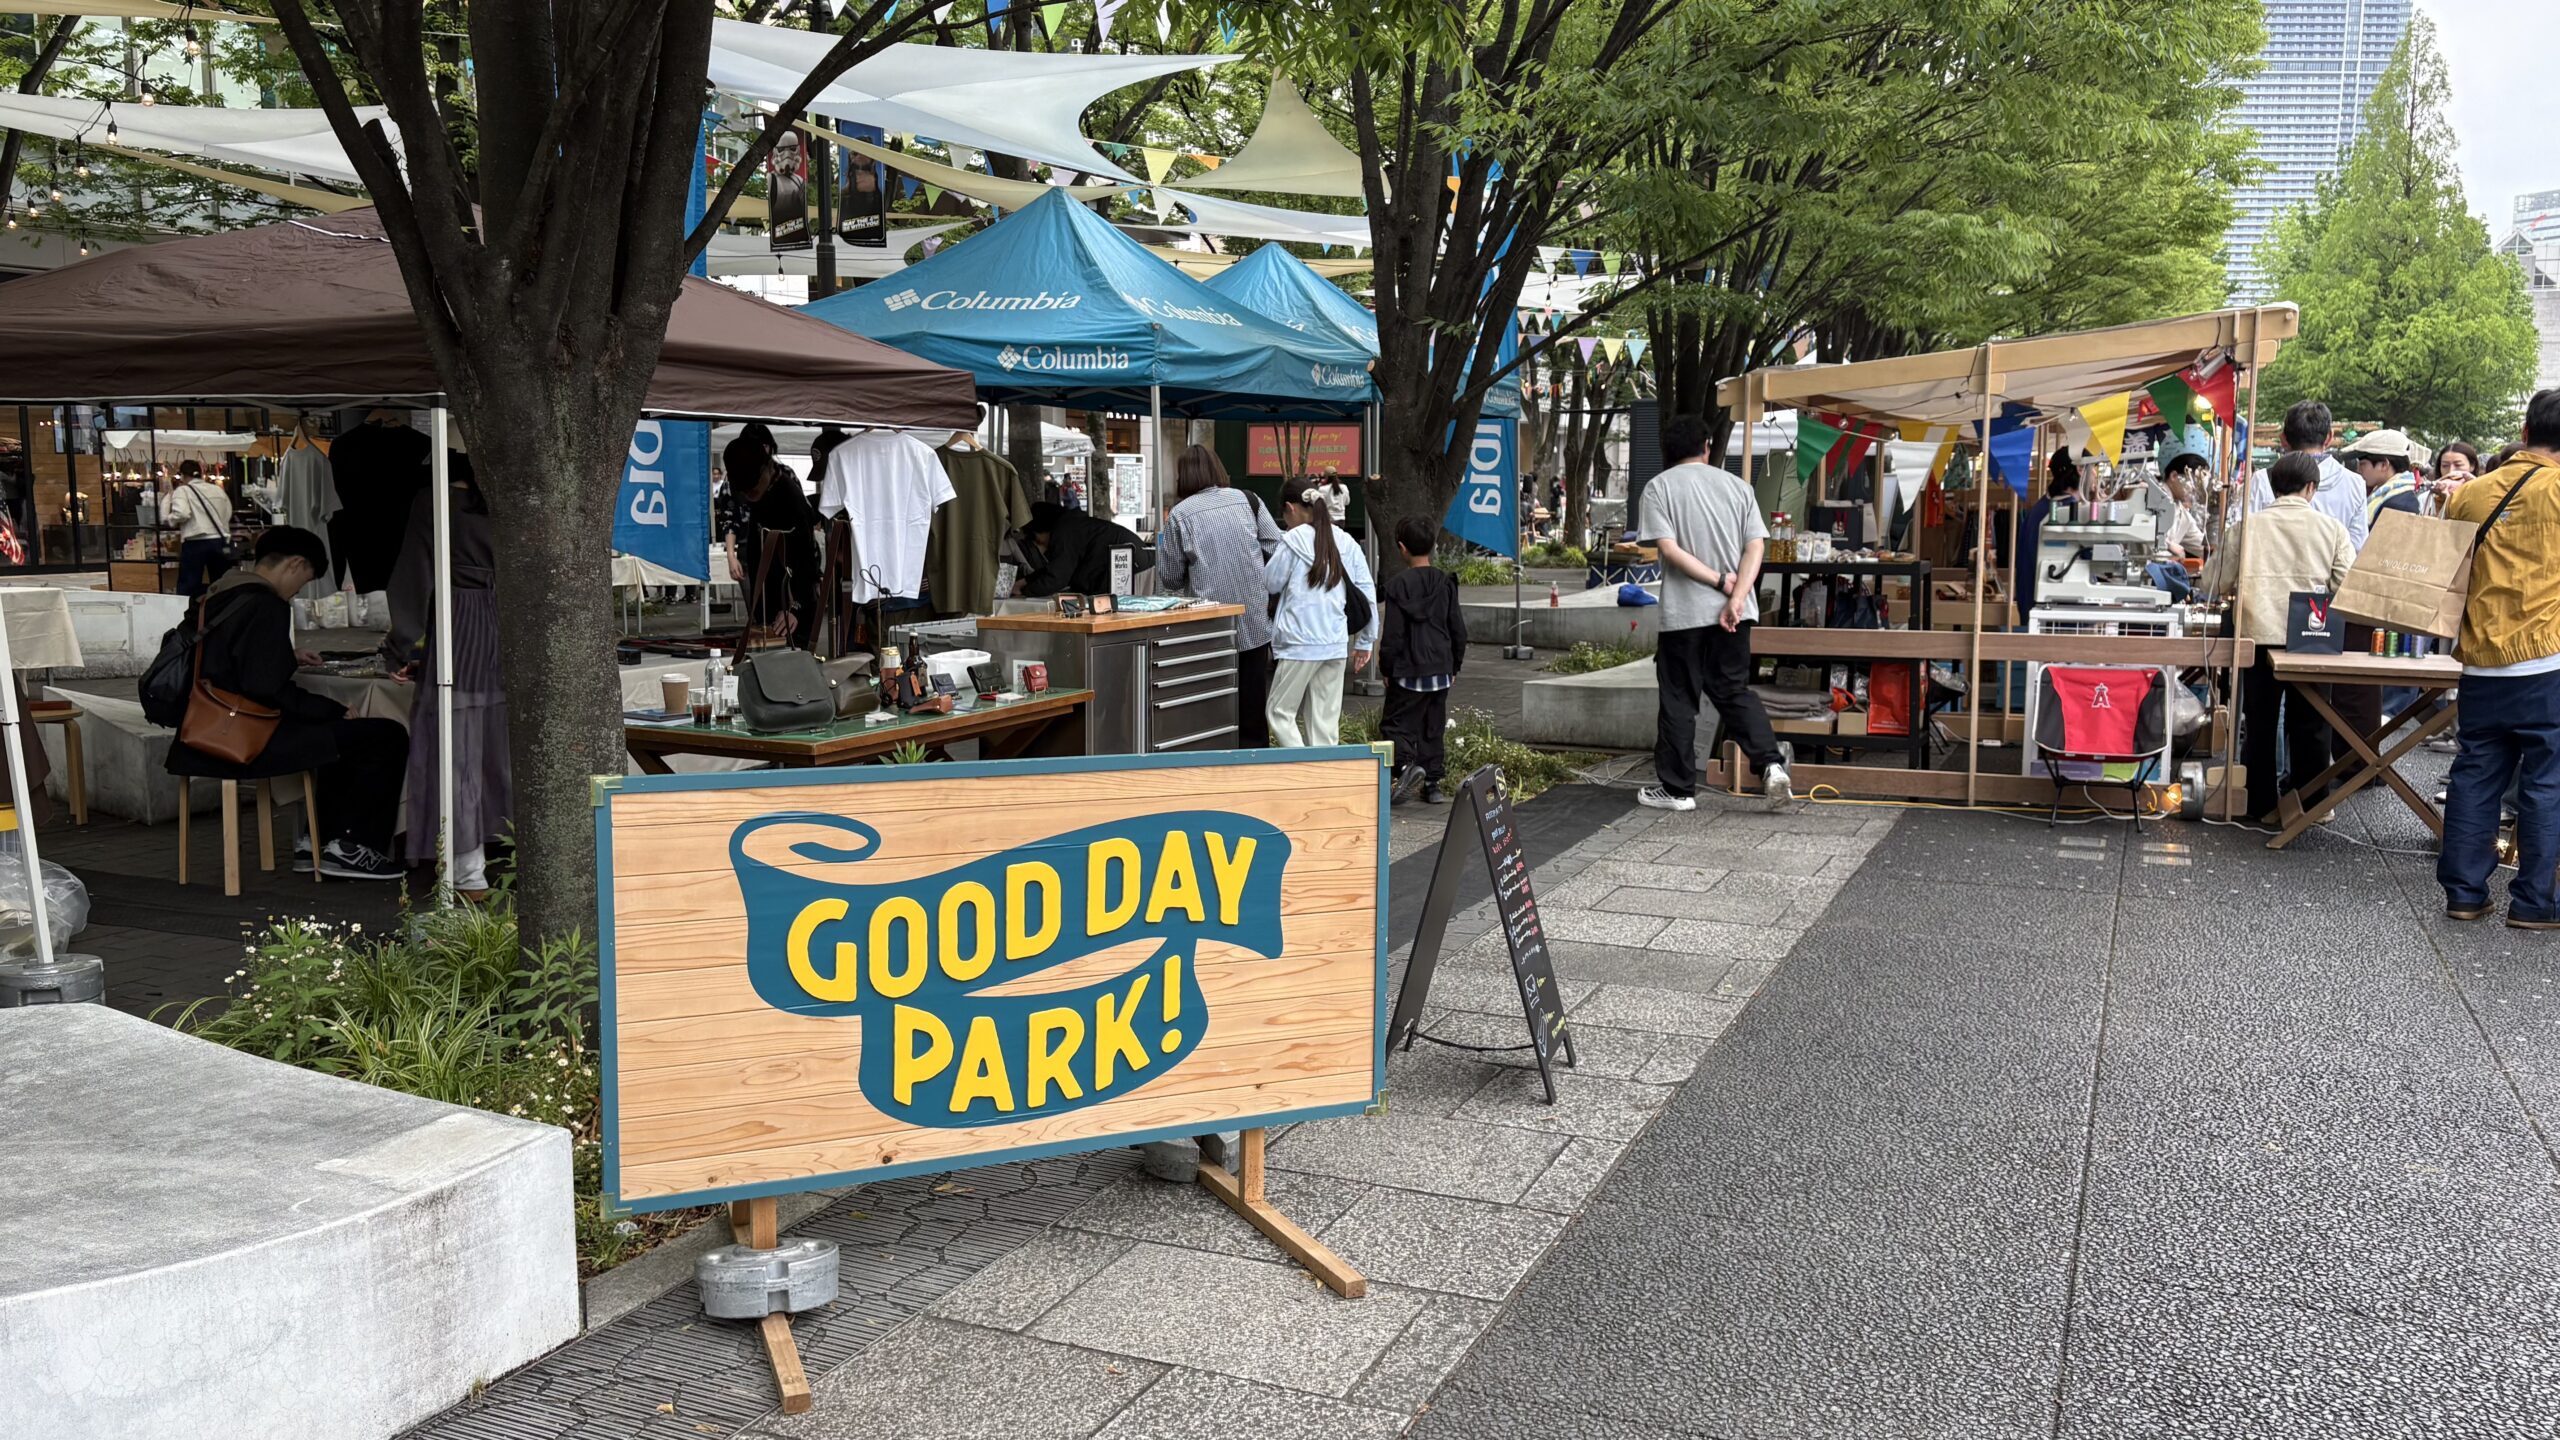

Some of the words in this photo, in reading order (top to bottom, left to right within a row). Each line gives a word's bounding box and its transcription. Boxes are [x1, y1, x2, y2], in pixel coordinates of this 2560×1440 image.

[920, 290, 1082, 311] Columbia
[1140, 297, 1243, 327] Columbia
[1022, 345, 1129, 371] Columbia
[1321, 364, 1365, 389] Columbia
[1114, 553, 1128, 562] Knot
[787, 860, 1062, 1002] GOOD
[1086, 830, 1258, 938] DAY
[893, 955, 1183, 1113] PARK!
